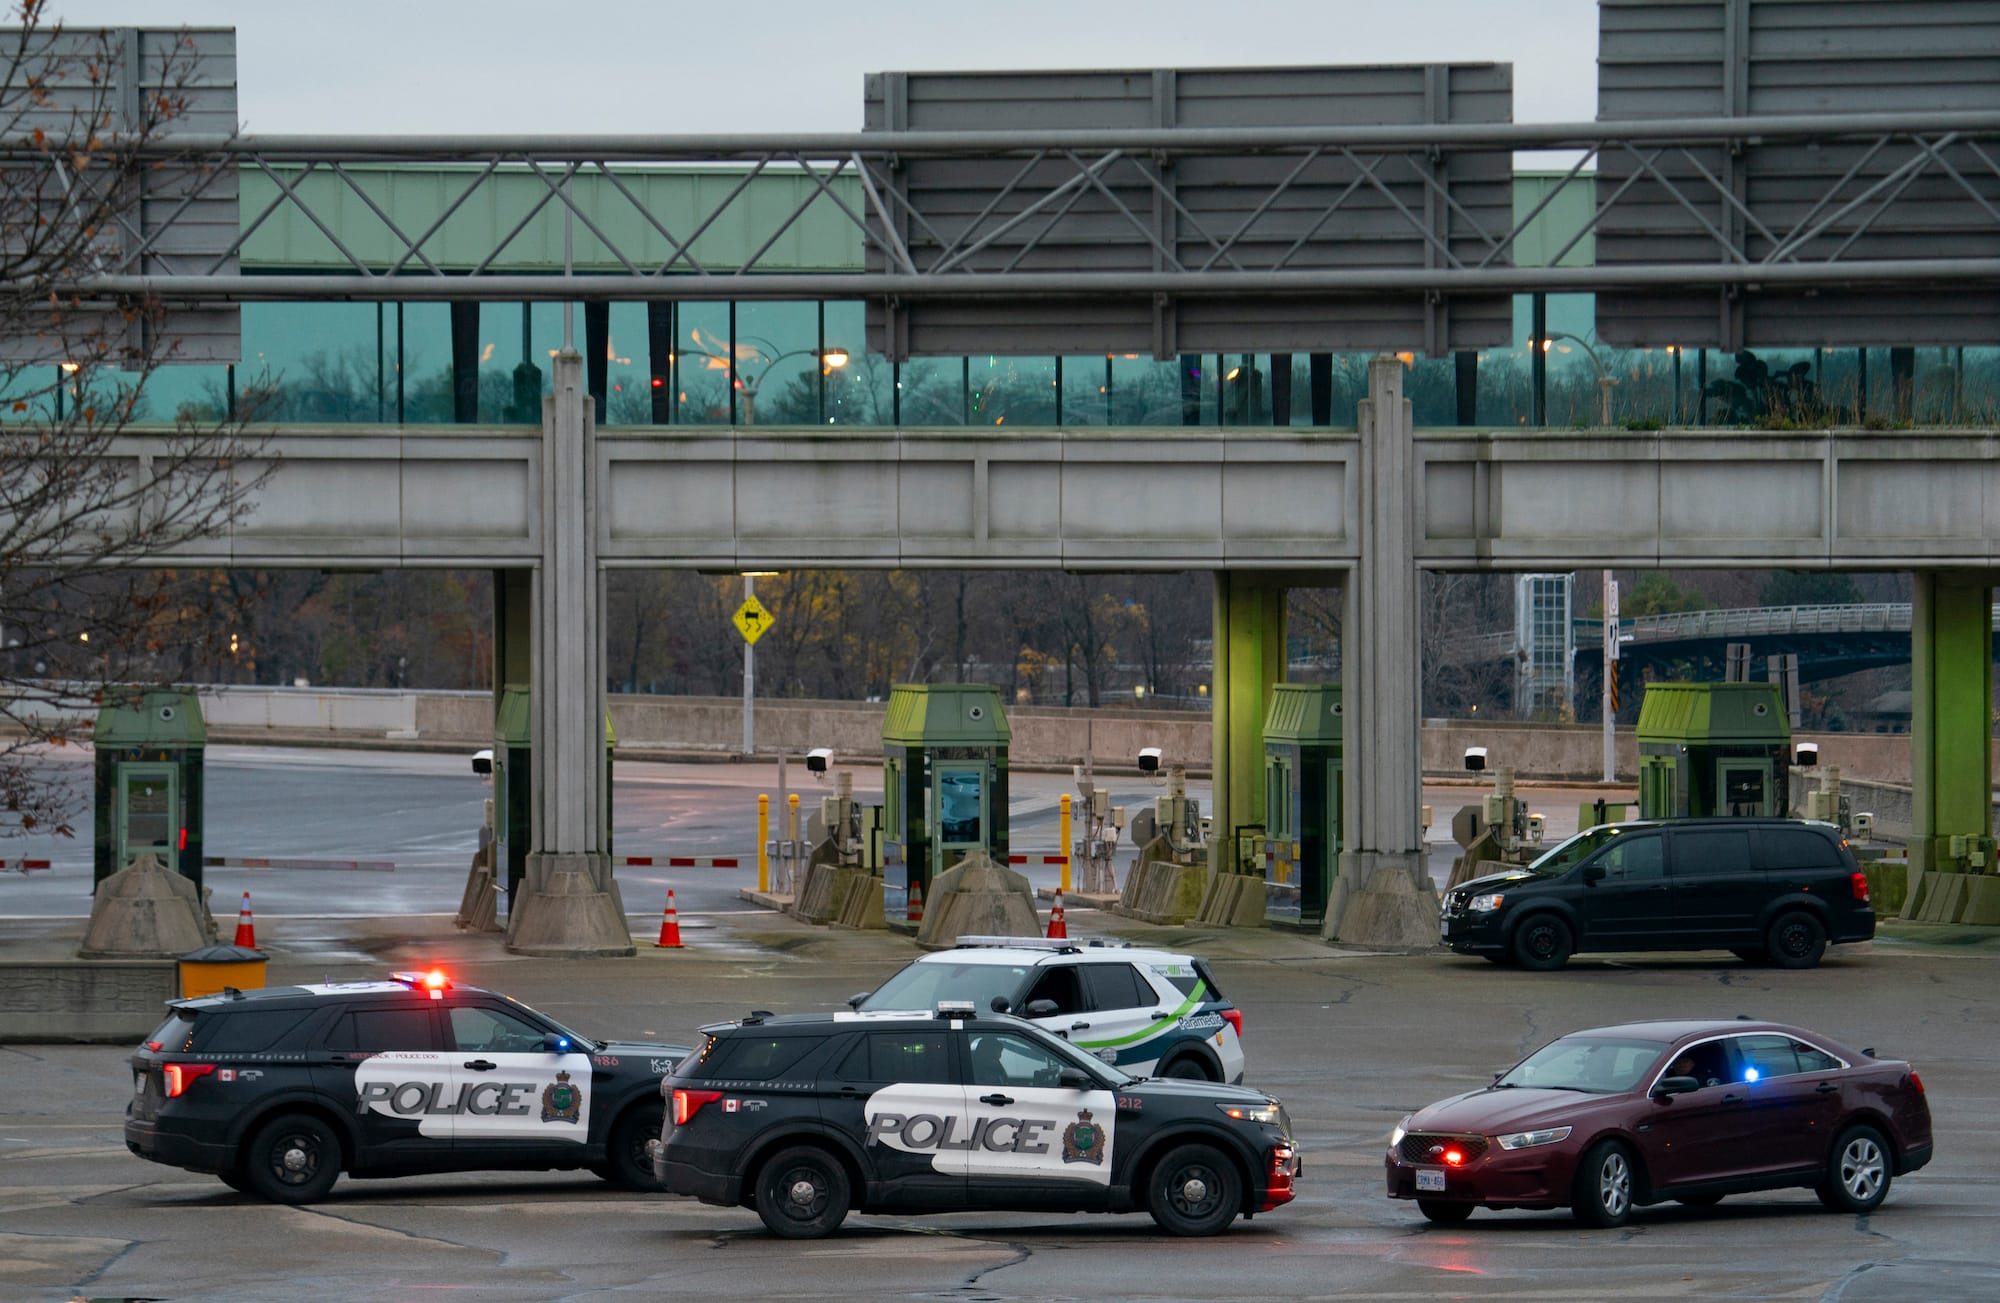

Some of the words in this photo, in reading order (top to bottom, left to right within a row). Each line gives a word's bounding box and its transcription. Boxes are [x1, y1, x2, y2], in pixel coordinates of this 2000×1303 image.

[1178, 1012, 1223, 1031] Paramedic
[594, 1055, 619, 1066] 486
[703, 1080, 751, 1089] Niagara
[759, 1080, 815, 1090] Regional
[356, 1081, 537, 1116] POLICE
[1119, 1096, 1142, 1110] 212
[865, 1112, 1056, 1154] POLICE
